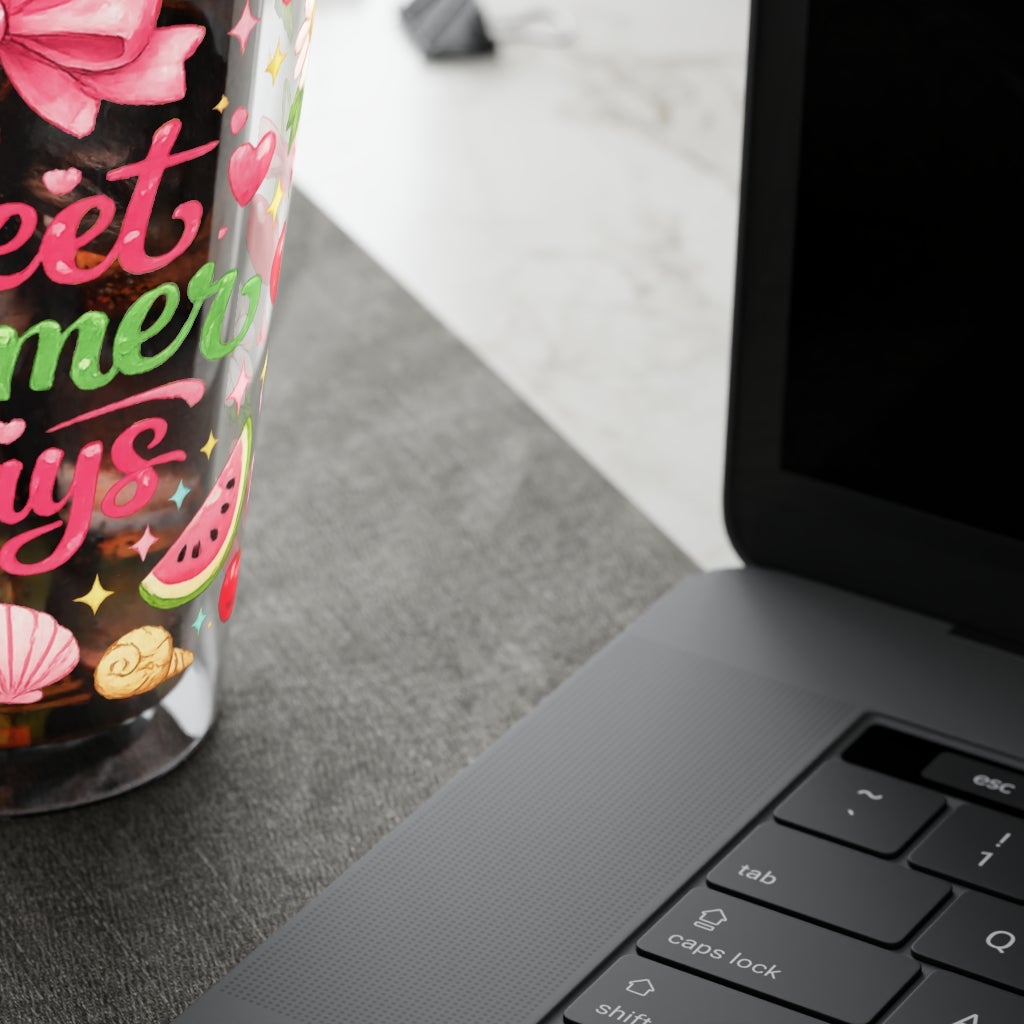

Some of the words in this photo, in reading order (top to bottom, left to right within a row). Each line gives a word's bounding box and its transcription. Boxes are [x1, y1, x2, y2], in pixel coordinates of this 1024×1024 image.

[972, 773, 1017, 795] esc
[994, 831, 1012, 848] !
[977, 850, 994, 867] 1
[737, 864, 777, 885] tab
[985, 930, 1017, 954] Q
[667, 933, 726, 960] caps
[728, 952, 782, 980] lock
[595, 1003, 653, 1024] shift
